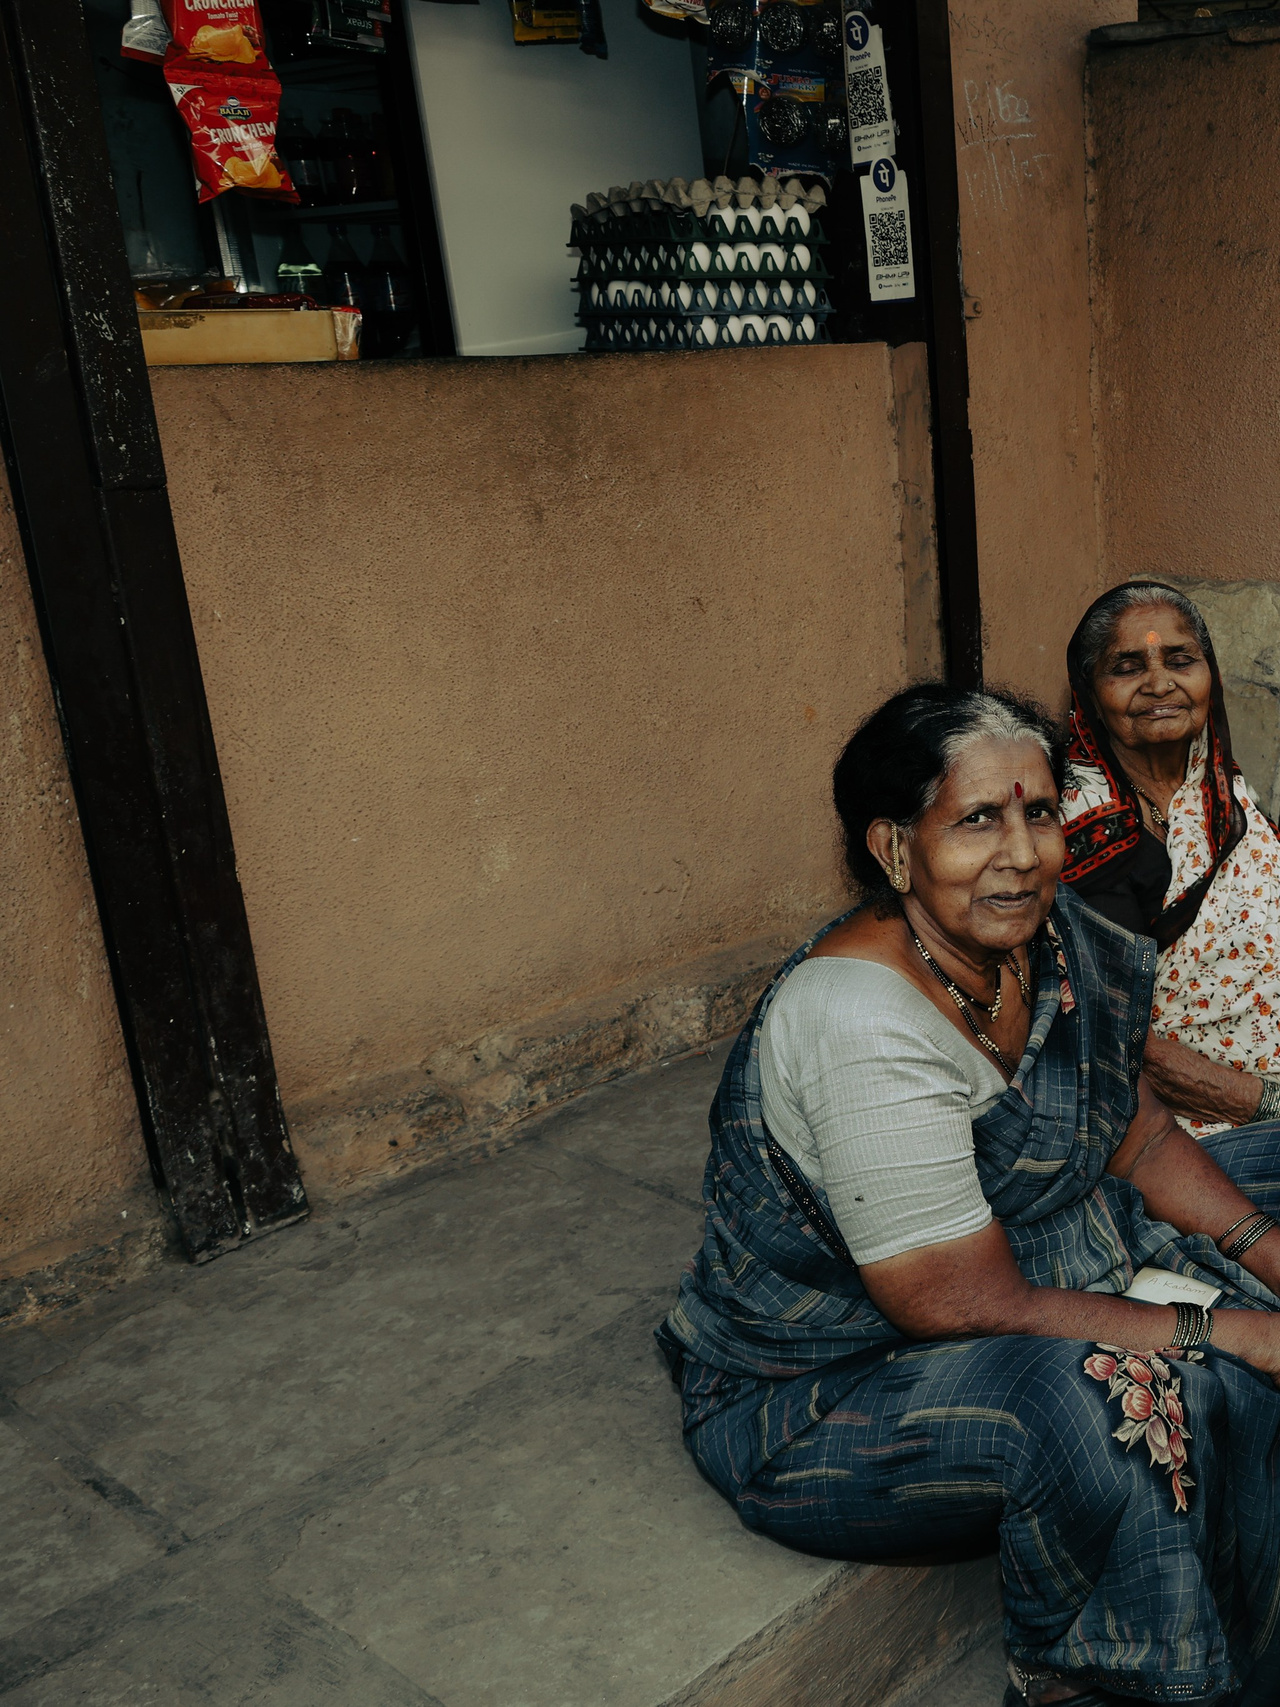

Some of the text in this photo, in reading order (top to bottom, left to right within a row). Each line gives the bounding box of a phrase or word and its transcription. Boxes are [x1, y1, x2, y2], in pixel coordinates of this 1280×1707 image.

[849, 51, 871, 63] PhonePe
[220, 108, 251, 116] BALAJI
[211, 121, 277, 143] CRUNCHEM
[878, 163, 890, 187] पे
[876, 195, 896, 203] PhonePe
